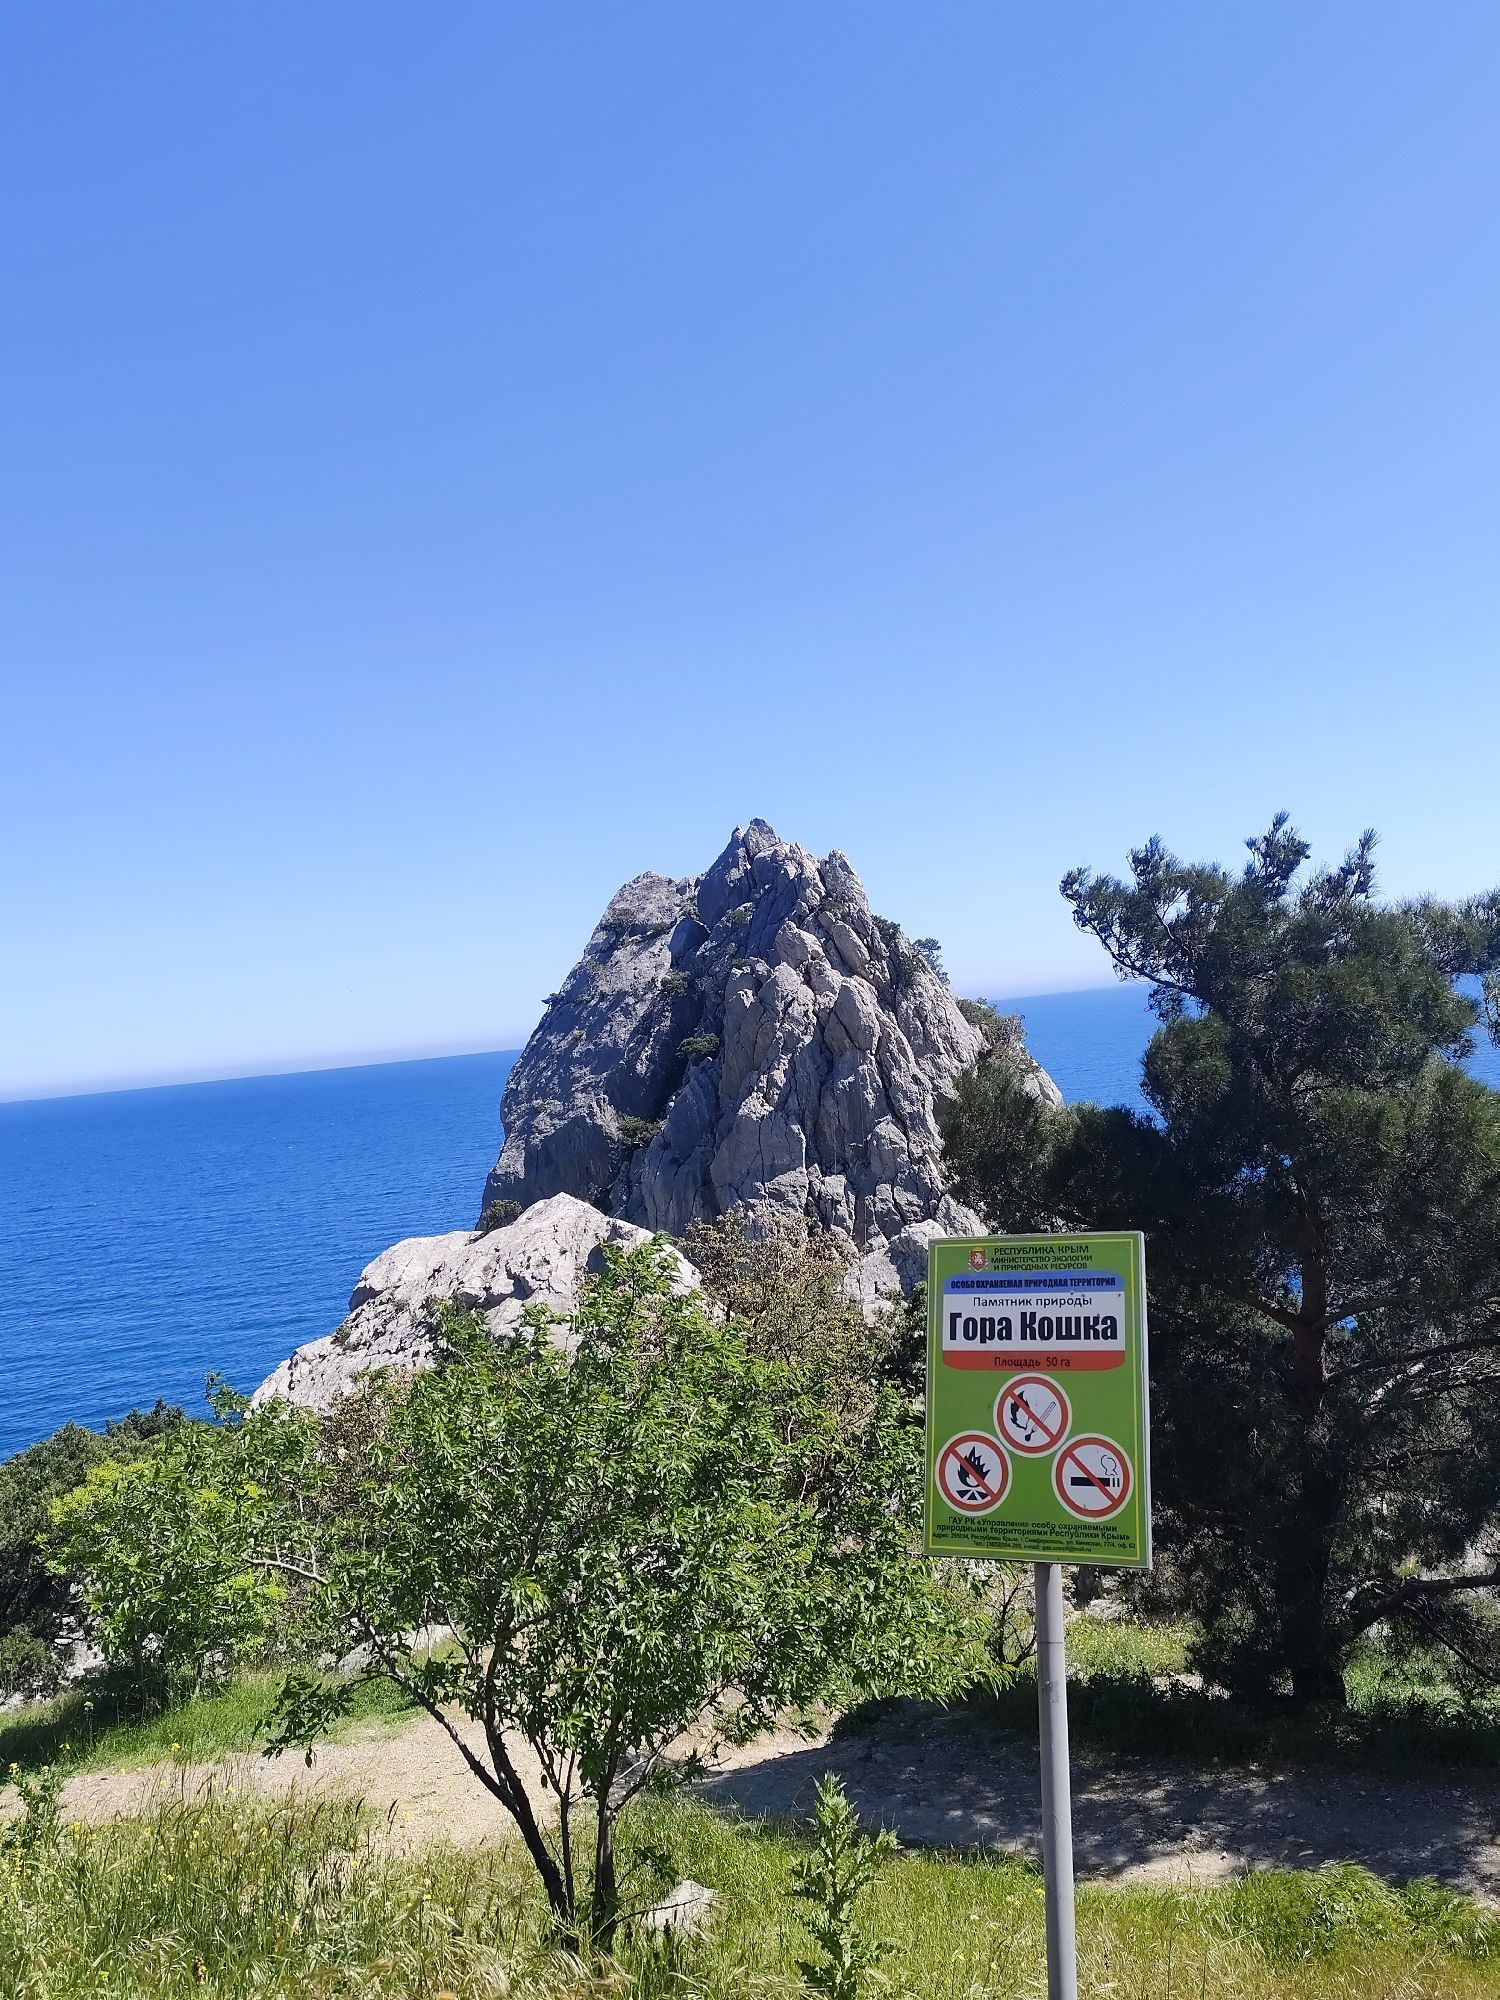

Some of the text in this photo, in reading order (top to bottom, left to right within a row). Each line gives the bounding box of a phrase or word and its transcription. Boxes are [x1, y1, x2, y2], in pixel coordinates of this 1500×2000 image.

[994, 1245, 1089, 1256] РЕСПУБЛИКА КРЫМ
[991, 1254, 1093, 1264] МИНИСТЕРСТВО ЭКОЛОГИИ
[1001, 1263, 1048, 1271] ПРИРОДНЫХ
[1050, 1262, 1088, 1270] РЕСУРСОВ
[951, 1277, 1116, 1289] ОСОБО ОХРАНЯЕМАЯ ПРИРОДНАЯ ТЕРРИТОРИЯ
[973, 1296, 1093, 1308] Памятник природы
[949, 1311, 1118, 1344] Гора Кошка
[994, 1356, 1071, 1367] Площадь 50 га
[948, 1516, 1118, 1532] ГАУ РК «Управление особо охраняемыми
[936, 1524, 1130, 1541] природными территориями Республики Крым»
